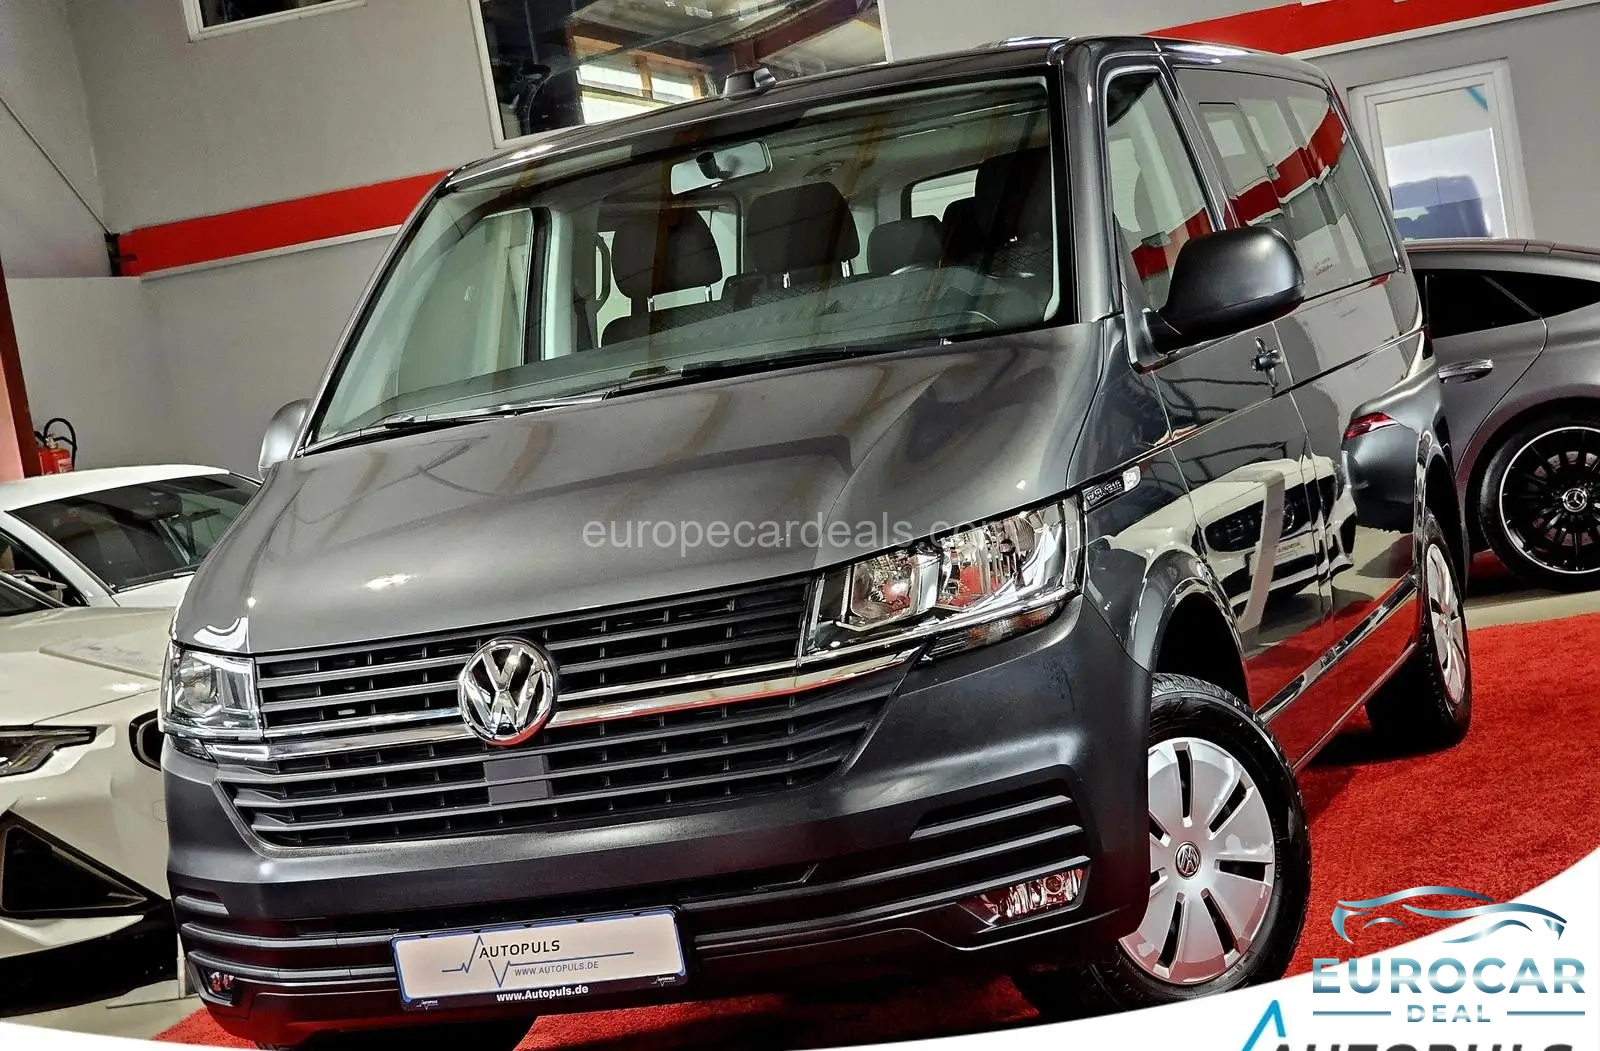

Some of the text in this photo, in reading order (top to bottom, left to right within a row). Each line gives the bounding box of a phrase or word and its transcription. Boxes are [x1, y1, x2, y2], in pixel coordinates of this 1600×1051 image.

[479, 940, 560, 959] AUTOPULS
[514, 961, 599, 977] WWW.AUTOPULS.DE
[496, 984, 589, 1002] www.Autopuls.de
